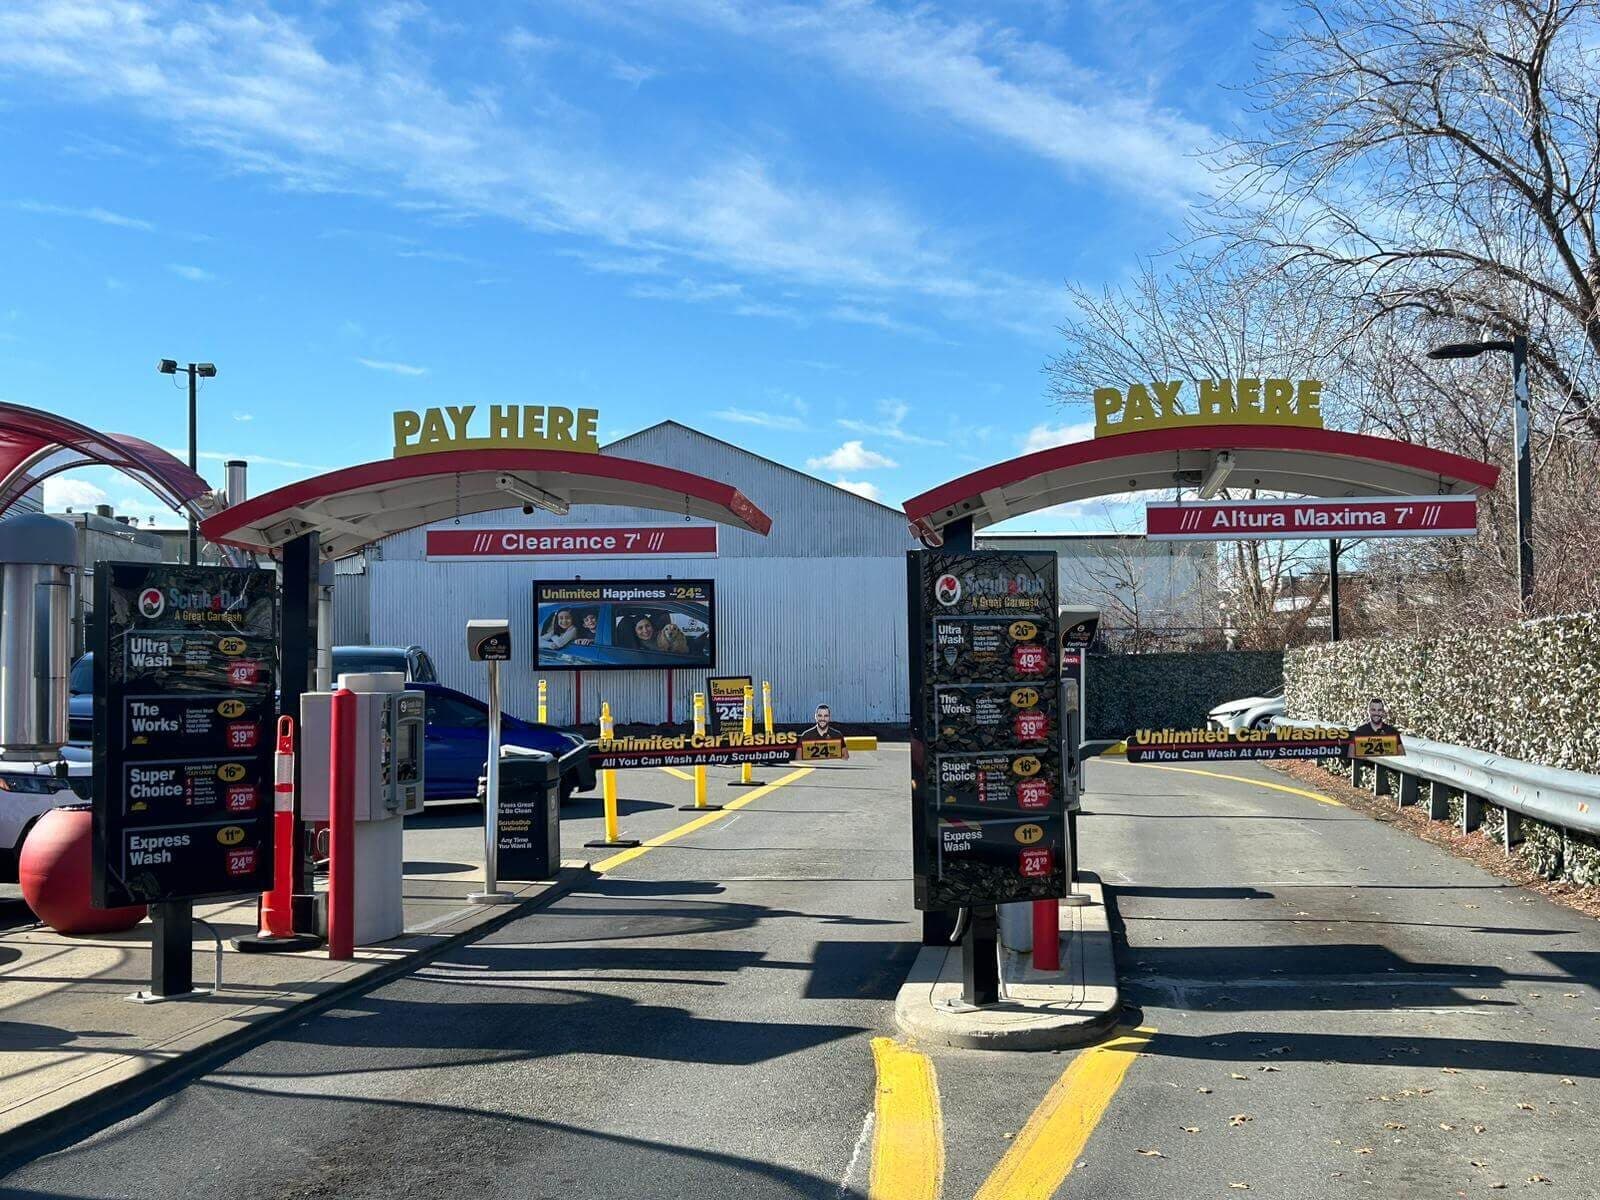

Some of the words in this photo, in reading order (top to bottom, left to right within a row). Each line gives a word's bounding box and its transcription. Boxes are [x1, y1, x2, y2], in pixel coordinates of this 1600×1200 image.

[1094, 380, 1183, 427] PAY
[1200, 378, 1323, 416] HERE
[393, 405, 476, 448] PAY
[490, 405, 599, 443] HERE
[1211, 509, 1284, 527] Altura
[1294, 508, 1386, 526] Maxima
[1394, 507, 1414, 525] 7'
[501, 533, 616, 551] Clearance
[623, 533, 641, 550] 7'
[541, 588, 600, 600] Unlimited
[602, 588, 666, 601] Happiness
[174, 610, 181, 621] A
[183, 610, 205, 622] Great
[938, 625, 962, 635] Ultra
[131, 638, 169, 653] Ultra
[938, 635, 964, 645] Wash
[131, 653, 172, 667] Wash
[939, 694, 958, 704] The
[131, 702, 159, 716] The
[942, 704, 971, 714] Works
[132, 717, 178, 732] Works
[598, 734, 685, 752] Unlimited
[691, 733, 723, 749] Car
[728, 730, 798, 747] Washes
[1136, 727, 1230, 745] Unlimited
[1235, 726, 1270, 743] Car
[1274, 726, 1350, 741] Washes
[602, 757, 616, 767] All
[618, 757, 637, 767] You
[641, 755, 662, 765] Can
[665, 754, 694, 764] Wash
[695, 753, 707, 763] At
[709, 753, 729, 764] Any
[732, 750, 790, 762] ScrubaDub
[1140, 750, 1155, 760] All
[1157, 750, 1179, 760] You
[1182, 749, 1204, 759] Can
[1207, 748, 1237, 758] Wash
[1240, 748, 1252, 758] At
[1255, 748, 1276, 759] Any
[1279, 746, 1341, 757] ScrubaDub
[942, 761, 971, 772] Super
[130, 769, 176, 784] Super
[942, 771, 976, 782] Choice
[130, 783, 183, 798] Choice
[130, 834, 191, 851] Express
[943, 830, 982, 842] Express
[943, 841, 971, 852] Wash
[130, 850, 171, 866] Wash
